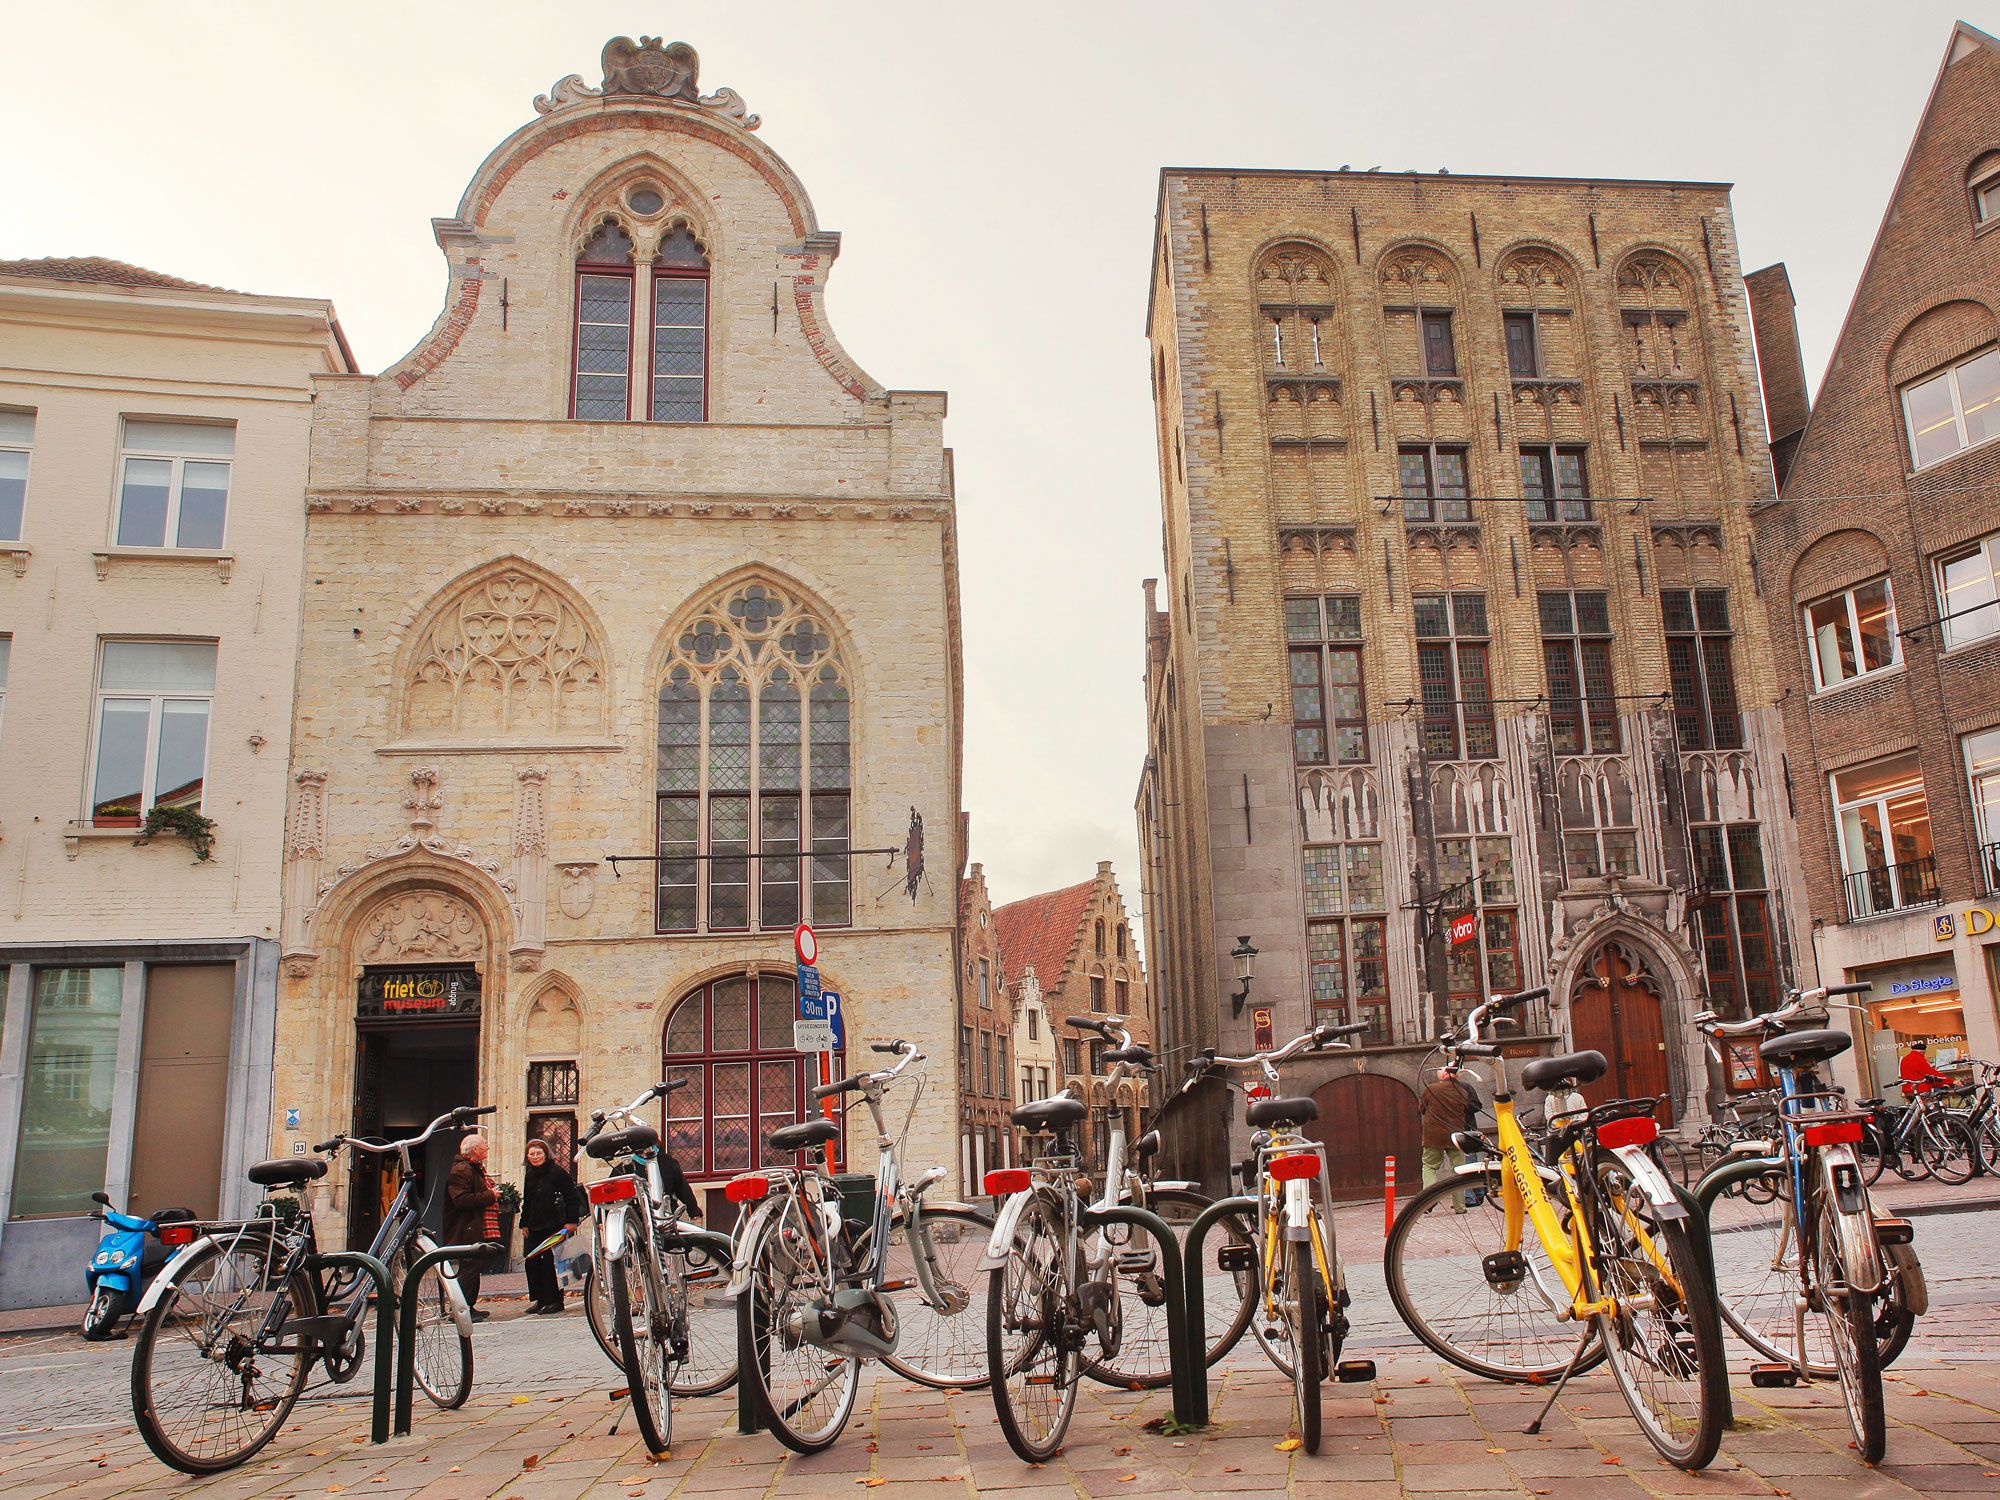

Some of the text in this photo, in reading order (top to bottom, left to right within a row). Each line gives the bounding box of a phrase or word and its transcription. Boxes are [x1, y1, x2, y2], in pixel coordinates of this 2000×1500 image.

[1963, 908, 2000, 937] D
[384, 980, 415, 998] friet
[448, 981, 459, 1006] Brugge
[1890, 976, 1953, 994] De Slegte
[383, 998, 446, 1009] museum
[826, 995, 837, 1015] P
[1873, 1035, 1962, 1051] inkoop van boeken
[295, 1144, 305, 1152] 33
